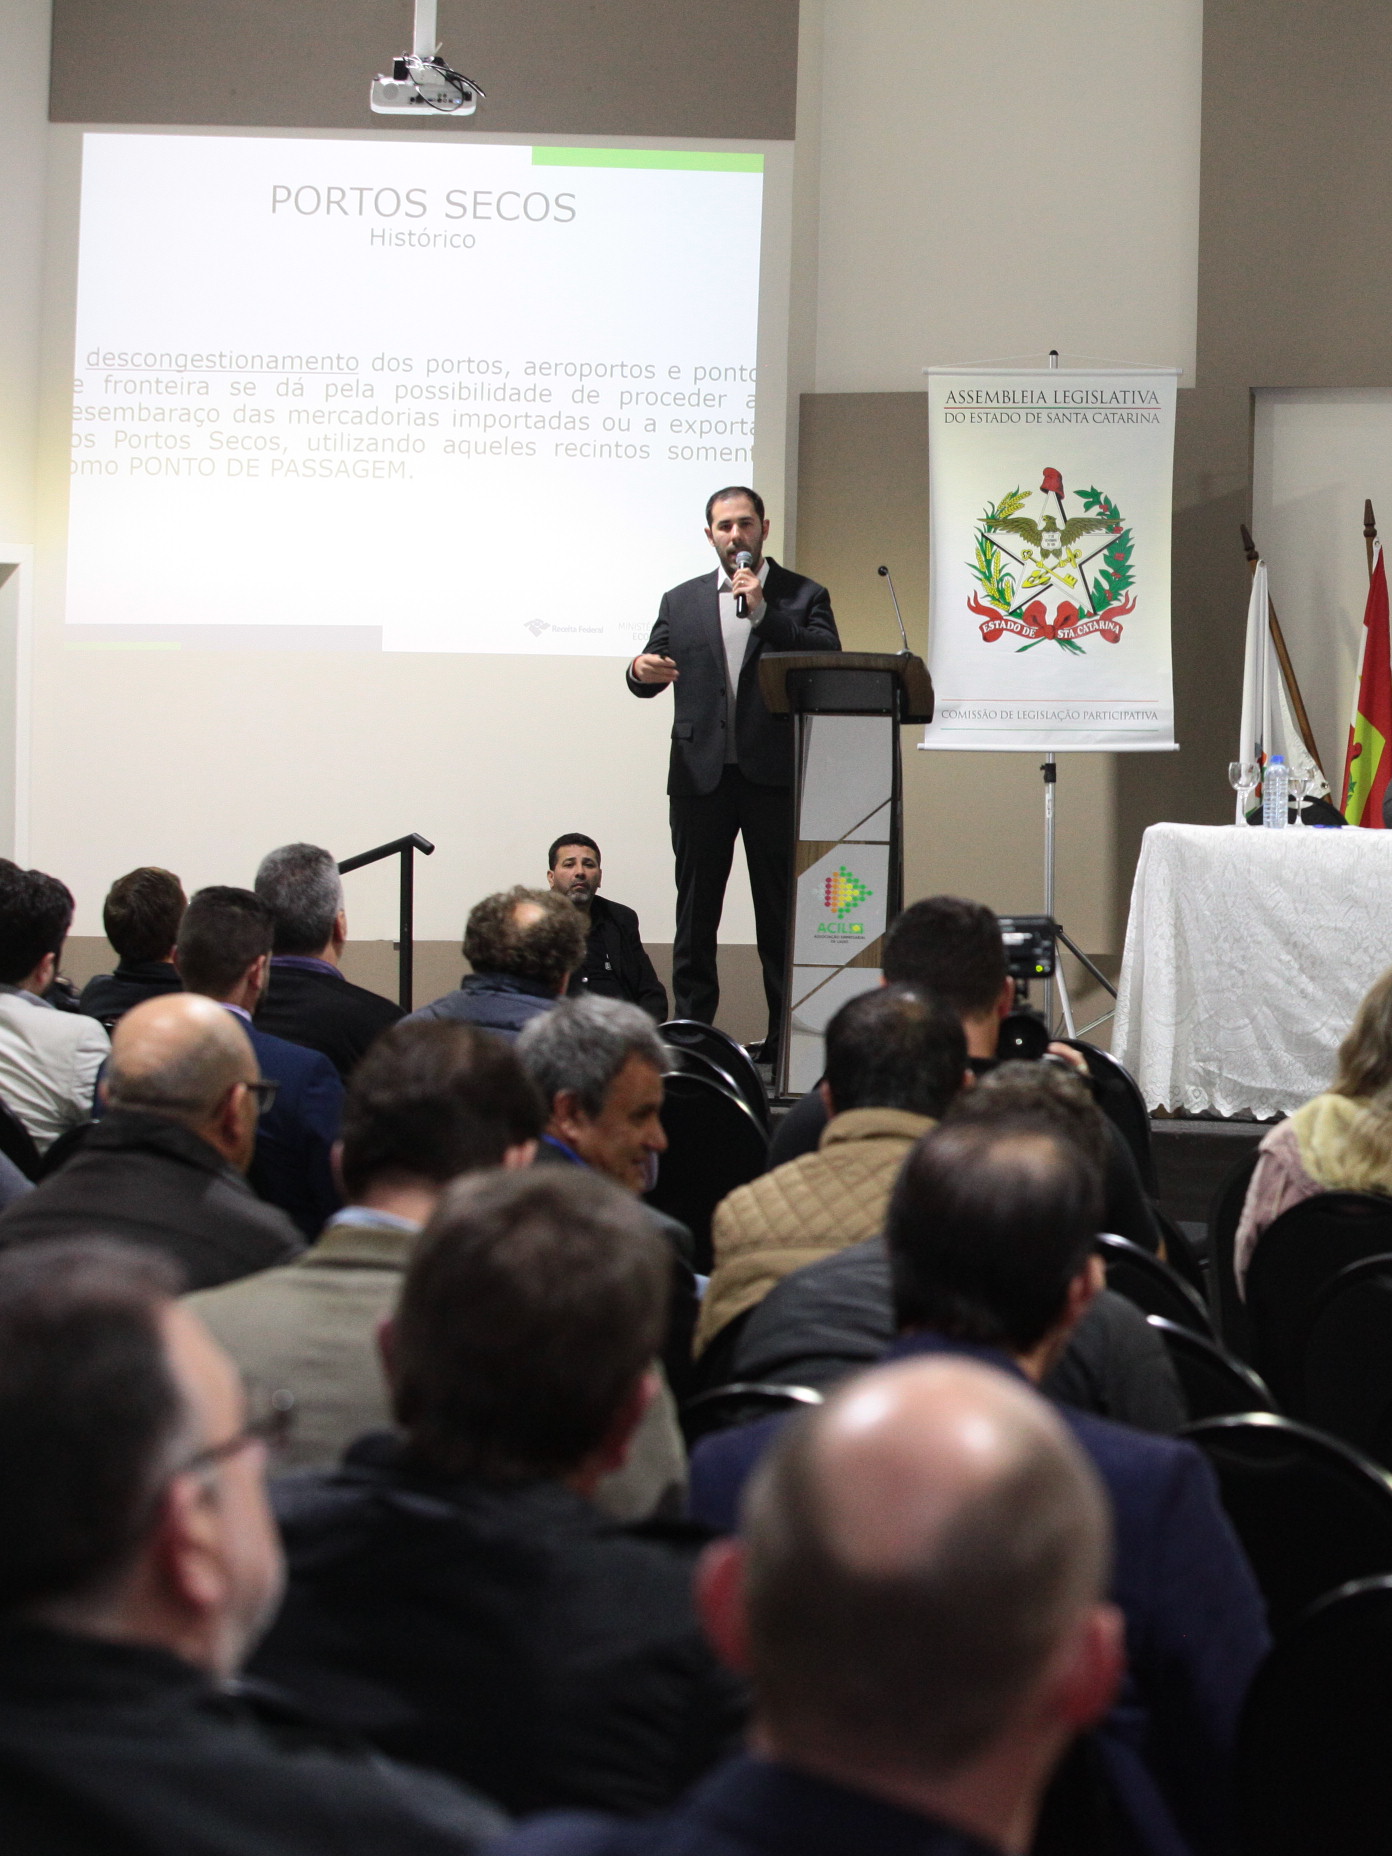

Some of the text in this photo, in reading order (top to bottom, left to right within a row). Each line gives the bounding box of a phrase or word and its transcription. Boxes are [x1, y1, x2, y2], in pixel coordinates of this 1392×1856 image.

[271, 184, 577, 223] PORTOS SECOS
[370, 226, 476, 249] Histórico
[86, 347, 359, 373] descongestionamento
[372, 352, 413, 373] dos
[426, 356, 511, 379] portos,
[523, 361, 656, 382] aeroportos
[667, 365, 682, 380] e
[104, 374, 209, 396] fronteira
[229, 380, 257, 396] se
[276, 374, 304, 398] dá
[325, 378, 375, 403] pela
[394, 381, 553, 405] possibilidade
[571, 384, 600, 405] de
[620, 387, 728, 409] proceder
[945, 389, 1161, 405] ASSEMBLEIA LEGISLATIVA
[72, 402, 221, 427] esembaraço
[233, 404, 276, 424] das
[288, 406, 439, 427] mercadorias
[452, 410, 590, 433] importadas
[602, 417, 631, 432] ou
[643, 417, 657, 433] a
[944, 412, 1161, 424] DO ESTADO DE SANTA CATARINA
[114, 430, 191, 450] Portos
[209, 431, 288, 456] Secos,
[307, 433, 426, 454] utilizando
[443, 437, 537, 460] aqueles
[554, 439, 651, 460] recintos
[129, 456, 216, 477] PONTO
[226, 458, 260, 478] DE
[270, 459, 414, 480] PASSAGEM.
[552, 625, 604, 635] Receita Federal
[982, 621, 1021, 633] ESTADO
[1022, 625, 1038, 638] DE
[1077, 619, 1120, 634] CATARINA
[941, 709, 1158, 722] COMISSÃO DE LEGISLAÇÃO PARTICIPATIVA
[818, 923, 848, 934] ACIL
